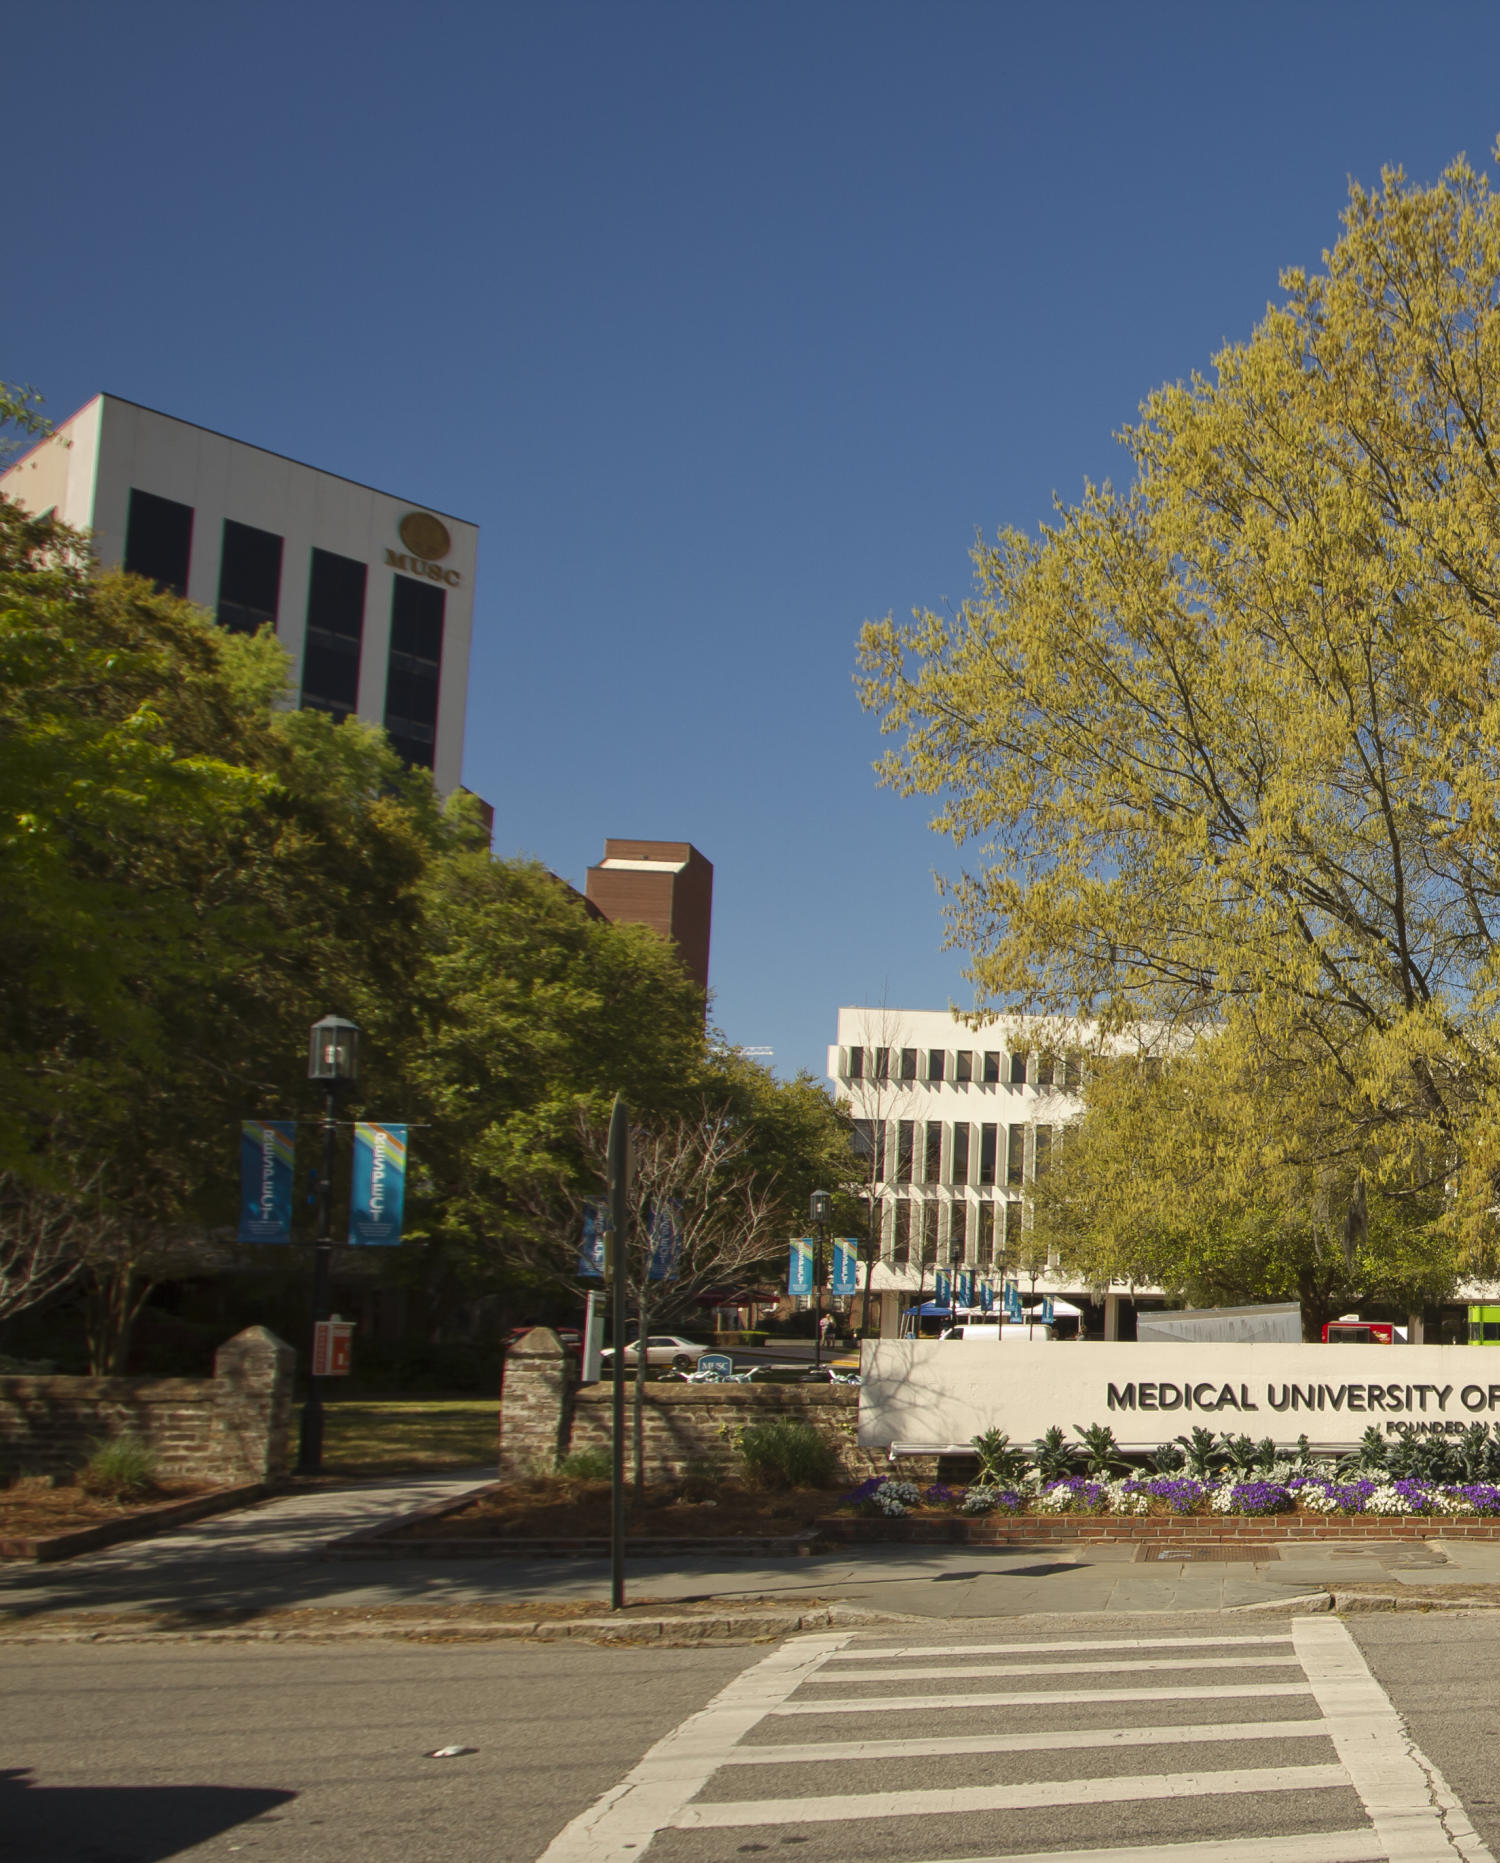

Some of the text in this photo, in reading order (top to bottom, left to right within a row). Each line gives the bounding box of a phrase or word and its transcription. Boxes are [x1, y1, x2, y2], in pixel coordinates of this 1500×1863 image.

[384, 548, 461, 587] MUSC
[260, 1129, 275, 1219] RESPECT
[370, 1132, 387, 1221] RESPECT
[1107, 1383, 1257, 1411] MEDICAL
[1267, 1384, 1452, 1411] UNIVERSITY
[1386, 1421, 1467, 1435] FOUNDED
